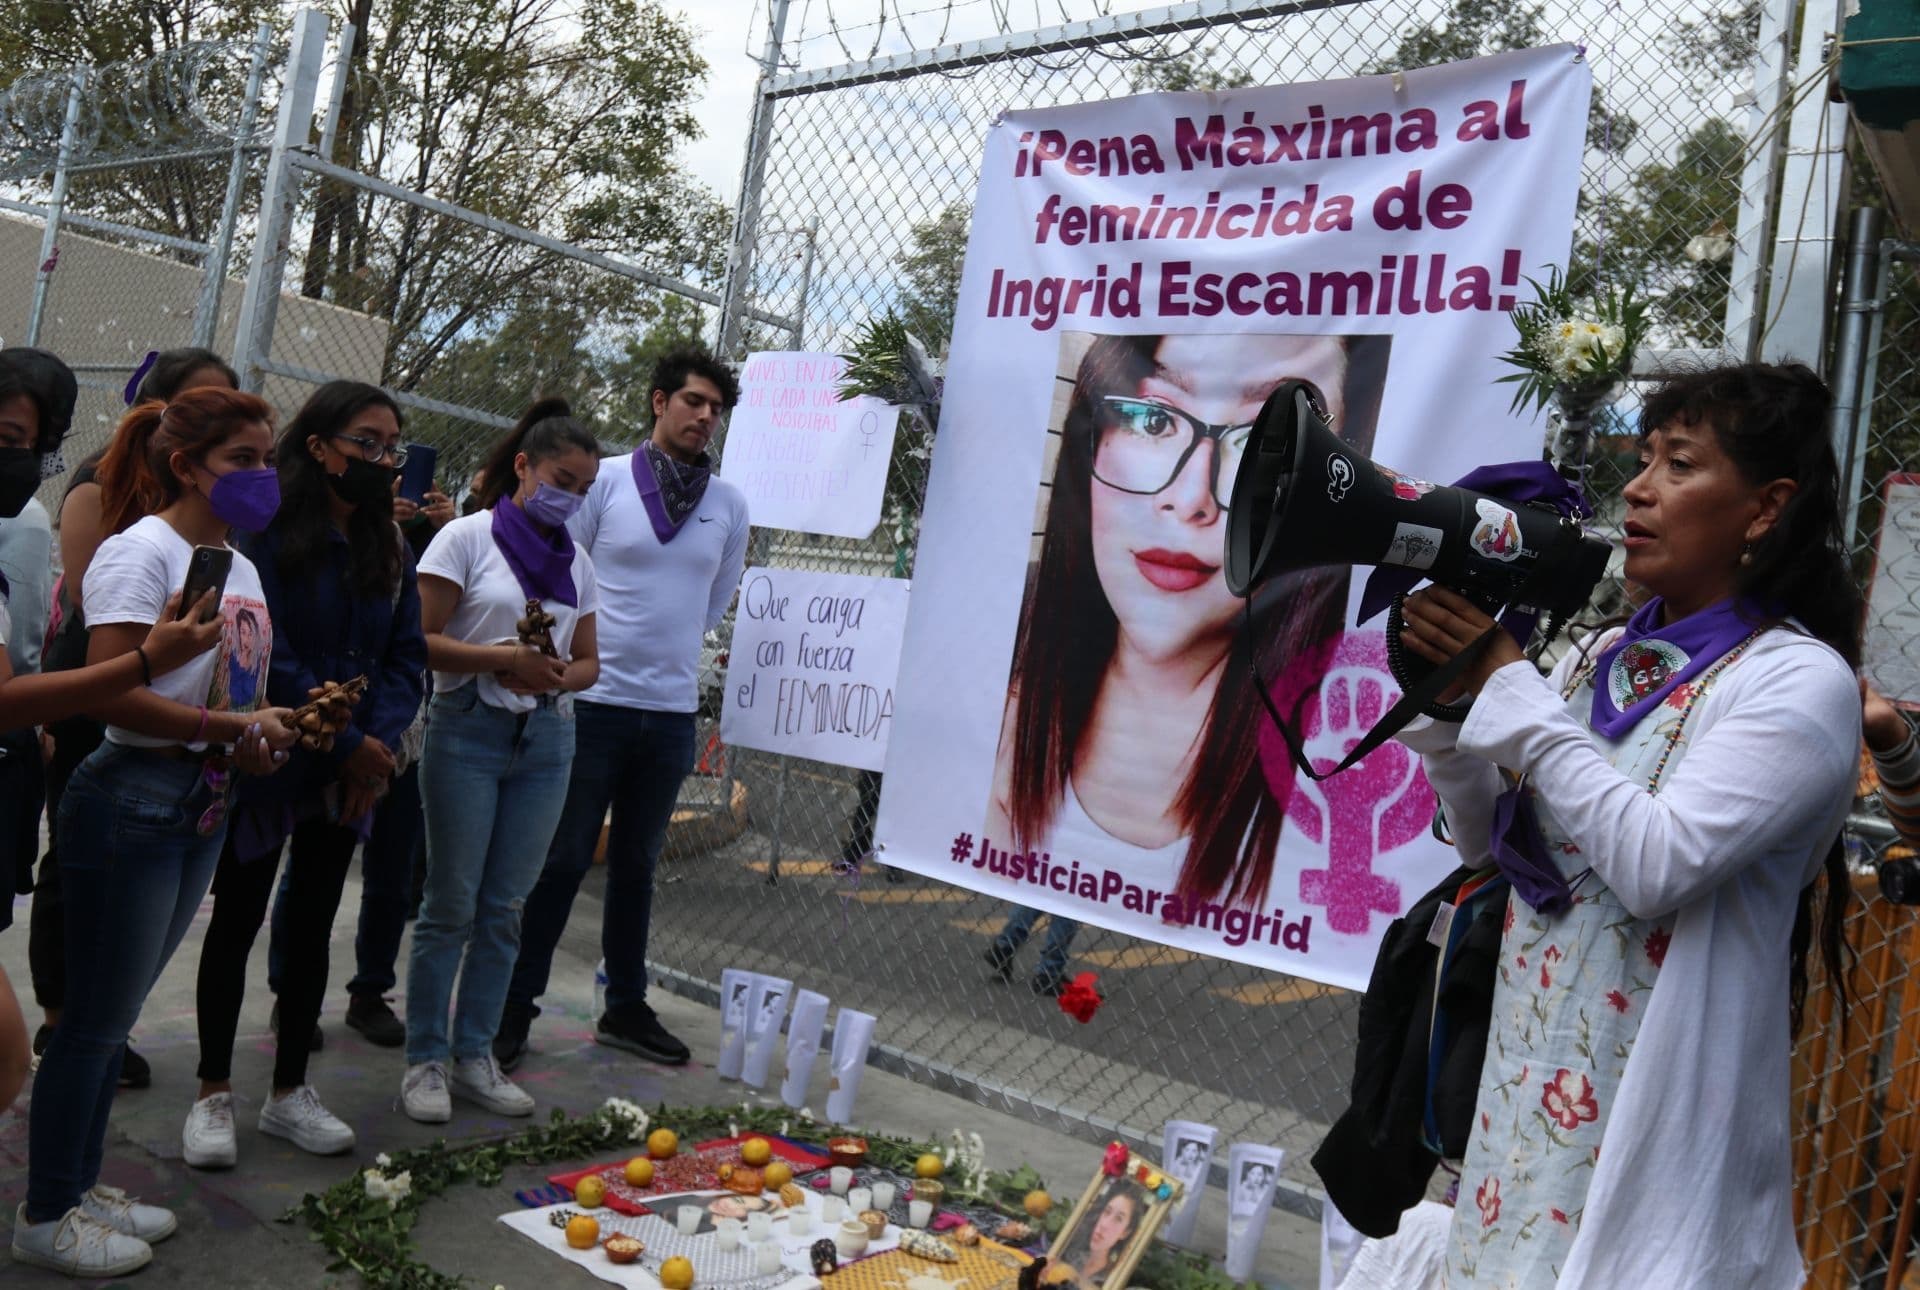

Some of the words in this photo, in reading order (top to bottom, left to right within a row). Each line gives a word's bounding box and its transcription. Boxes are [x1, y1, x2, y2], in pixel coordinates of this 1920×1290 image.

[1014, 129, 1165, 178] ¡Pena
[1174, 105, 1438, 171] Máxima
[1456, 79, 1530, 142] al
[1035, 184, 1353, 245] feminicida
[1373, 170, 1472, 231] de
[986, 262, 1141, 331] Ingrid
[1158, 249, 1522, 316] Escamilla!
[748, 360, 787, 383] VIVES
[796, 358, 816, 384] EN
[750, 387, 765, 407] DE
[771, 387, 806, 408] CADA
[771, 409, 837, 432] NOSOTRAS
[745, 575, 789, 622] Que
[807, 595, 865, 638] caiga
[756, 639, 784, 668] con
[797, 632, 854, 672] fuerza
[737, 673, 757, 709] el
[774, 678, 895, 740] FEMINICIDA
[951, 832, 1312, 953] #JusticiaParaIngrid
